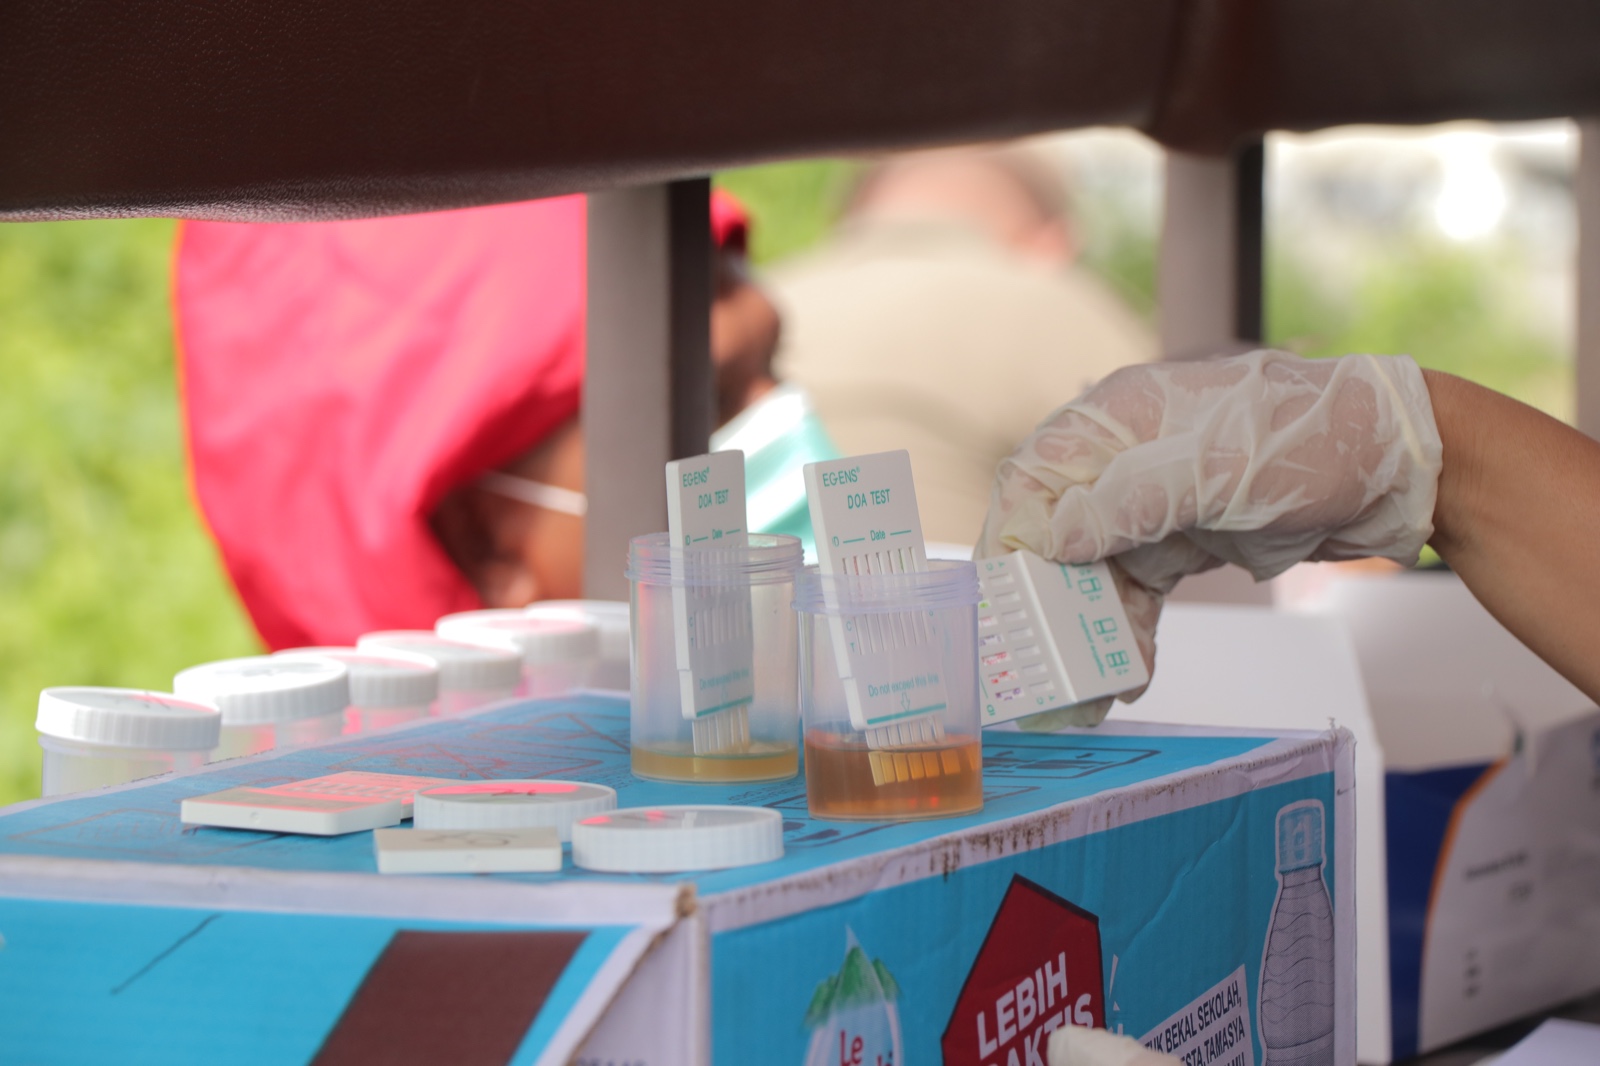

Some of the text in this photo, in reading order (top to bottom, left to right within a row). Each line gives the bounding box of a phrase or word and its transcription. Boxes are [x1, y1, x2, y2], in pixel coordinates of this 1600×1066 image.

[698, 488, 730, 510] DOA TEST
[847, 488, 890, 510] DOA TEST
[870, 530, 886, 542] Date
[868, 684, 879, 698] Do
[880, 682, 890, 695] not
[891, 676, 915, 692] exceed
[914, 675, 927, 689] this
[977, 951, 1068, 1060] LEBIH
[1165, 1012, 1198, 1053] BEKAL
[1198, 980, 1242, 1031] SEKOLAH,
